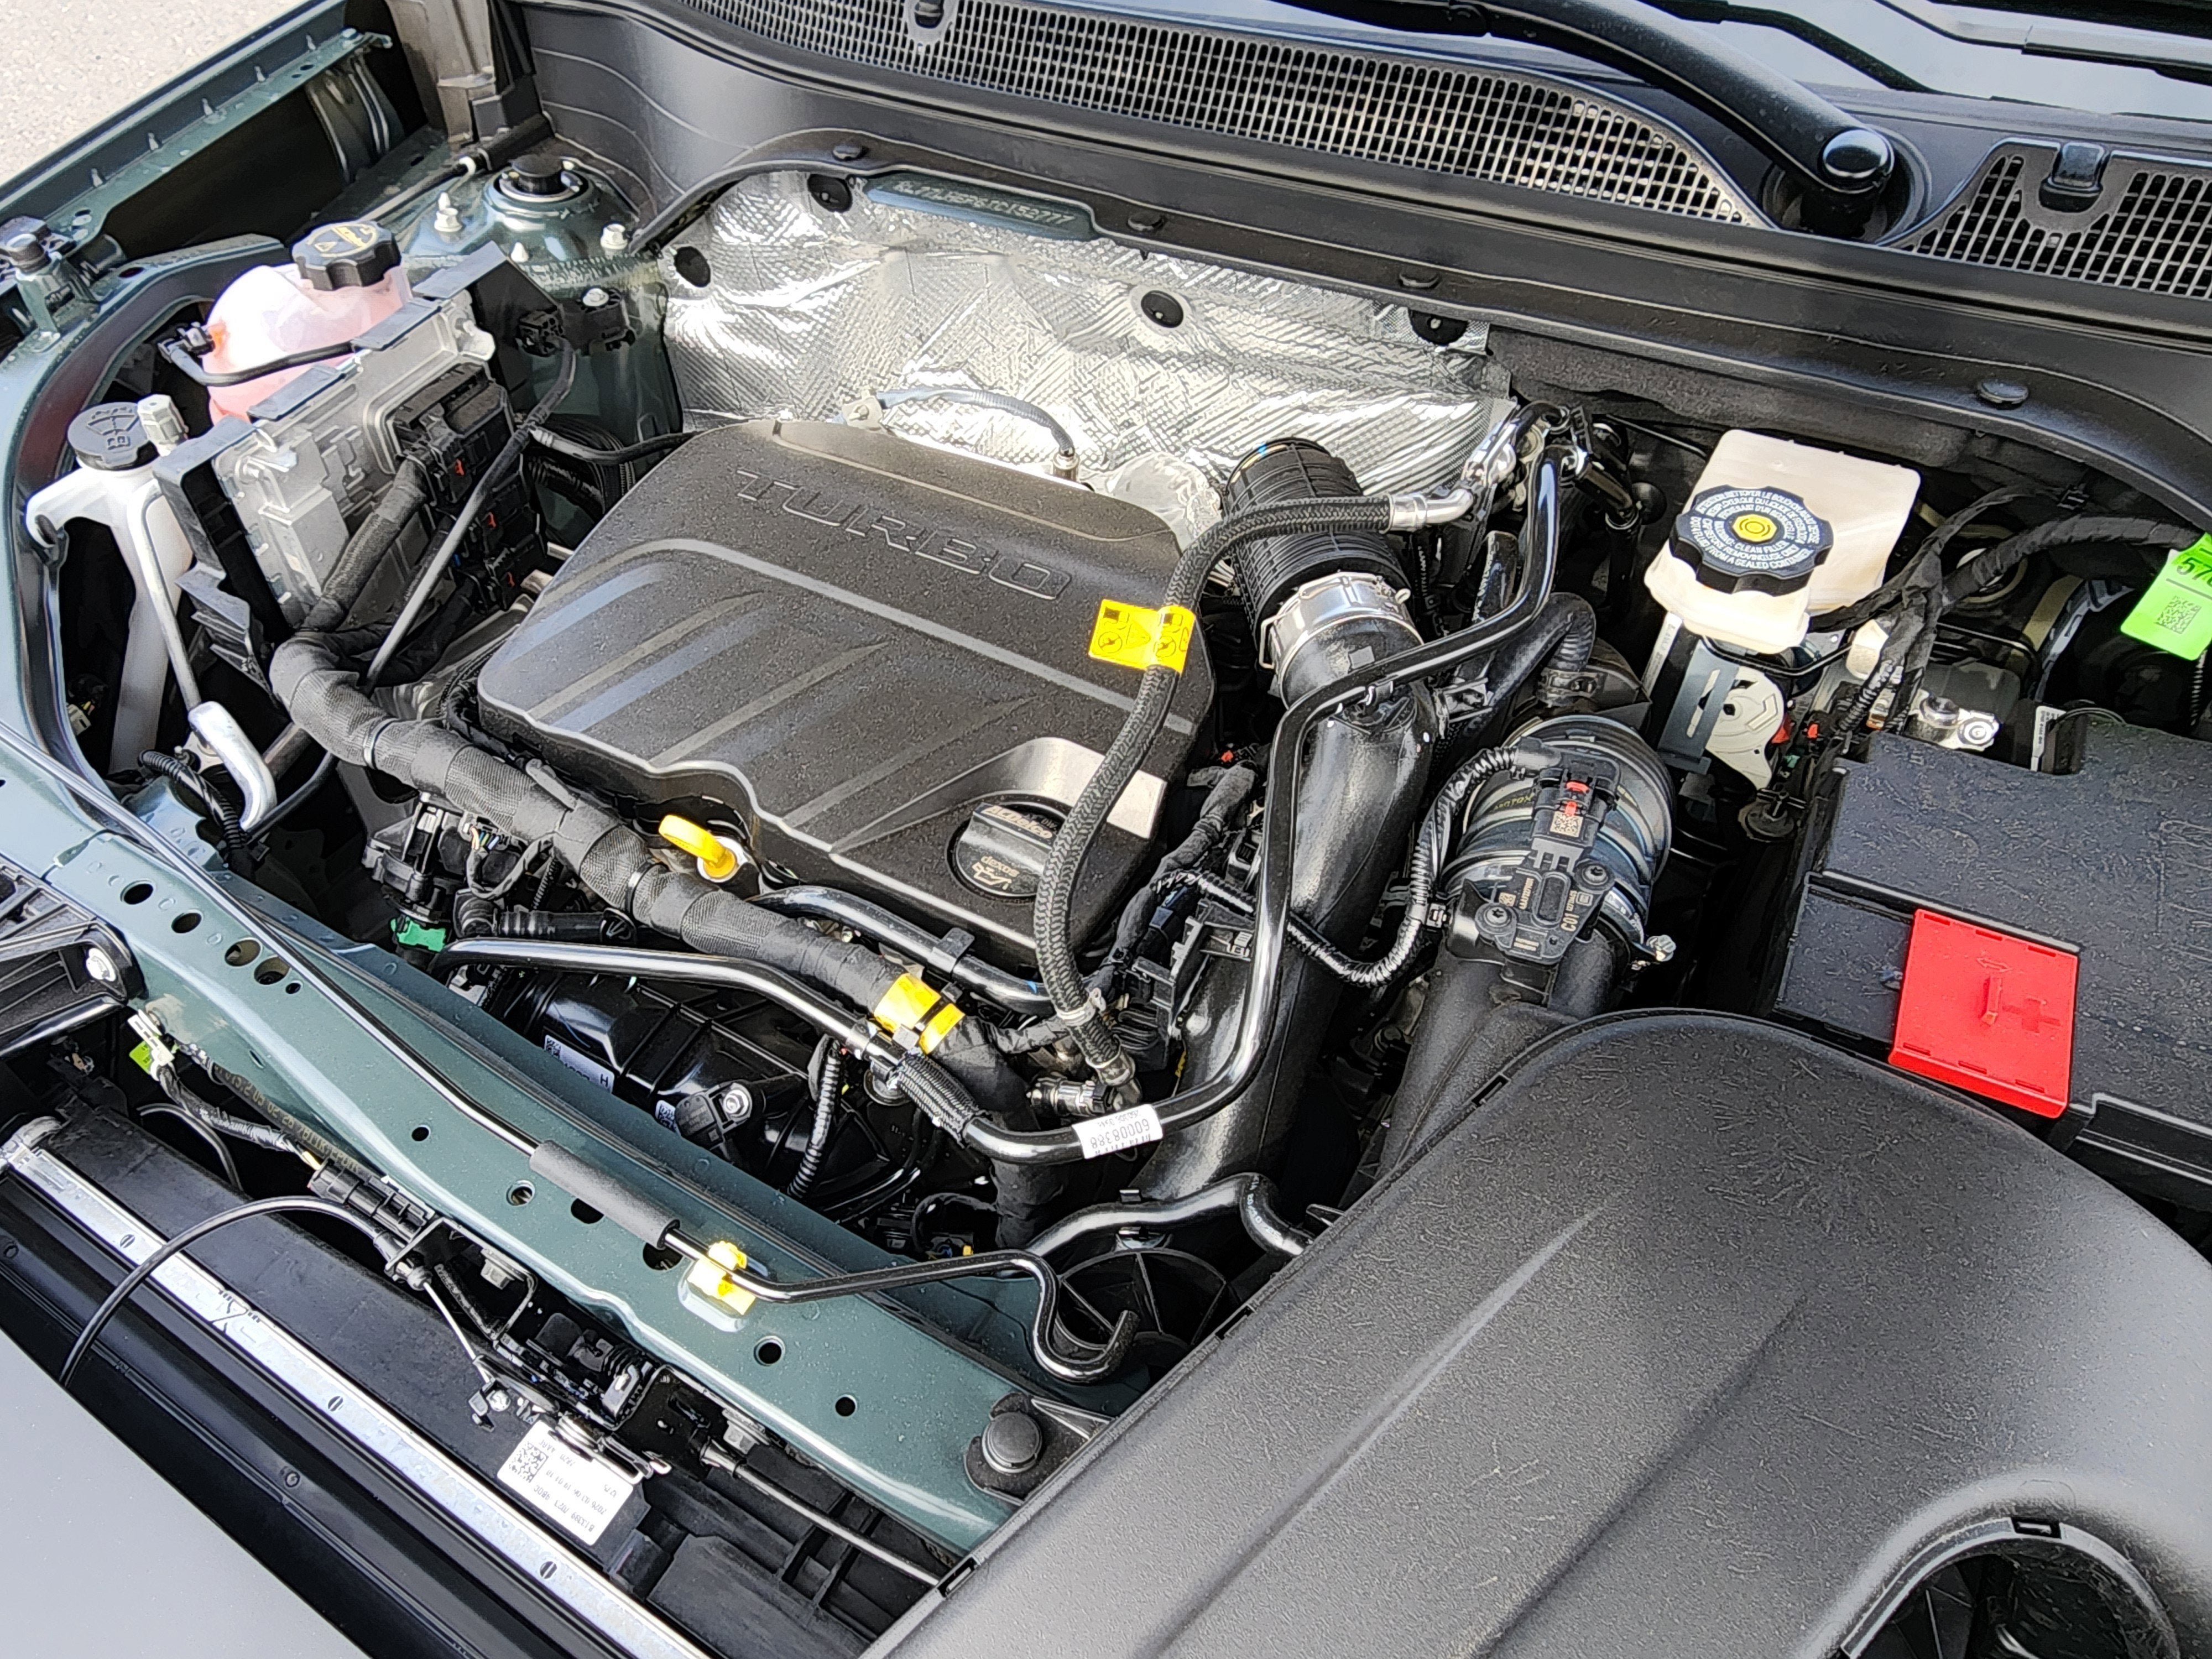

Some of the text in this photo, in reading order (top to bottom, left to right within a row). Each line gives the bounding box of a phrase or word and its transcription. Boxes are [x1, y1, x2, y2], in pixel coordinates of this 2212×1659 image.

[735, 469, 1072, 601] TURBO
[1705, 545, 1729, 561] FROM
[1735, 559, 1769, 569] SEALED
[1735, 542, 1762, 553] CLEAN
[980, 805, 1053, 839] ACDelco
[980, 855, 1020, 877] dexos
[1561, 914, 1580, 932] C01
[1091, 1119, 1150, 1149] 60008388
